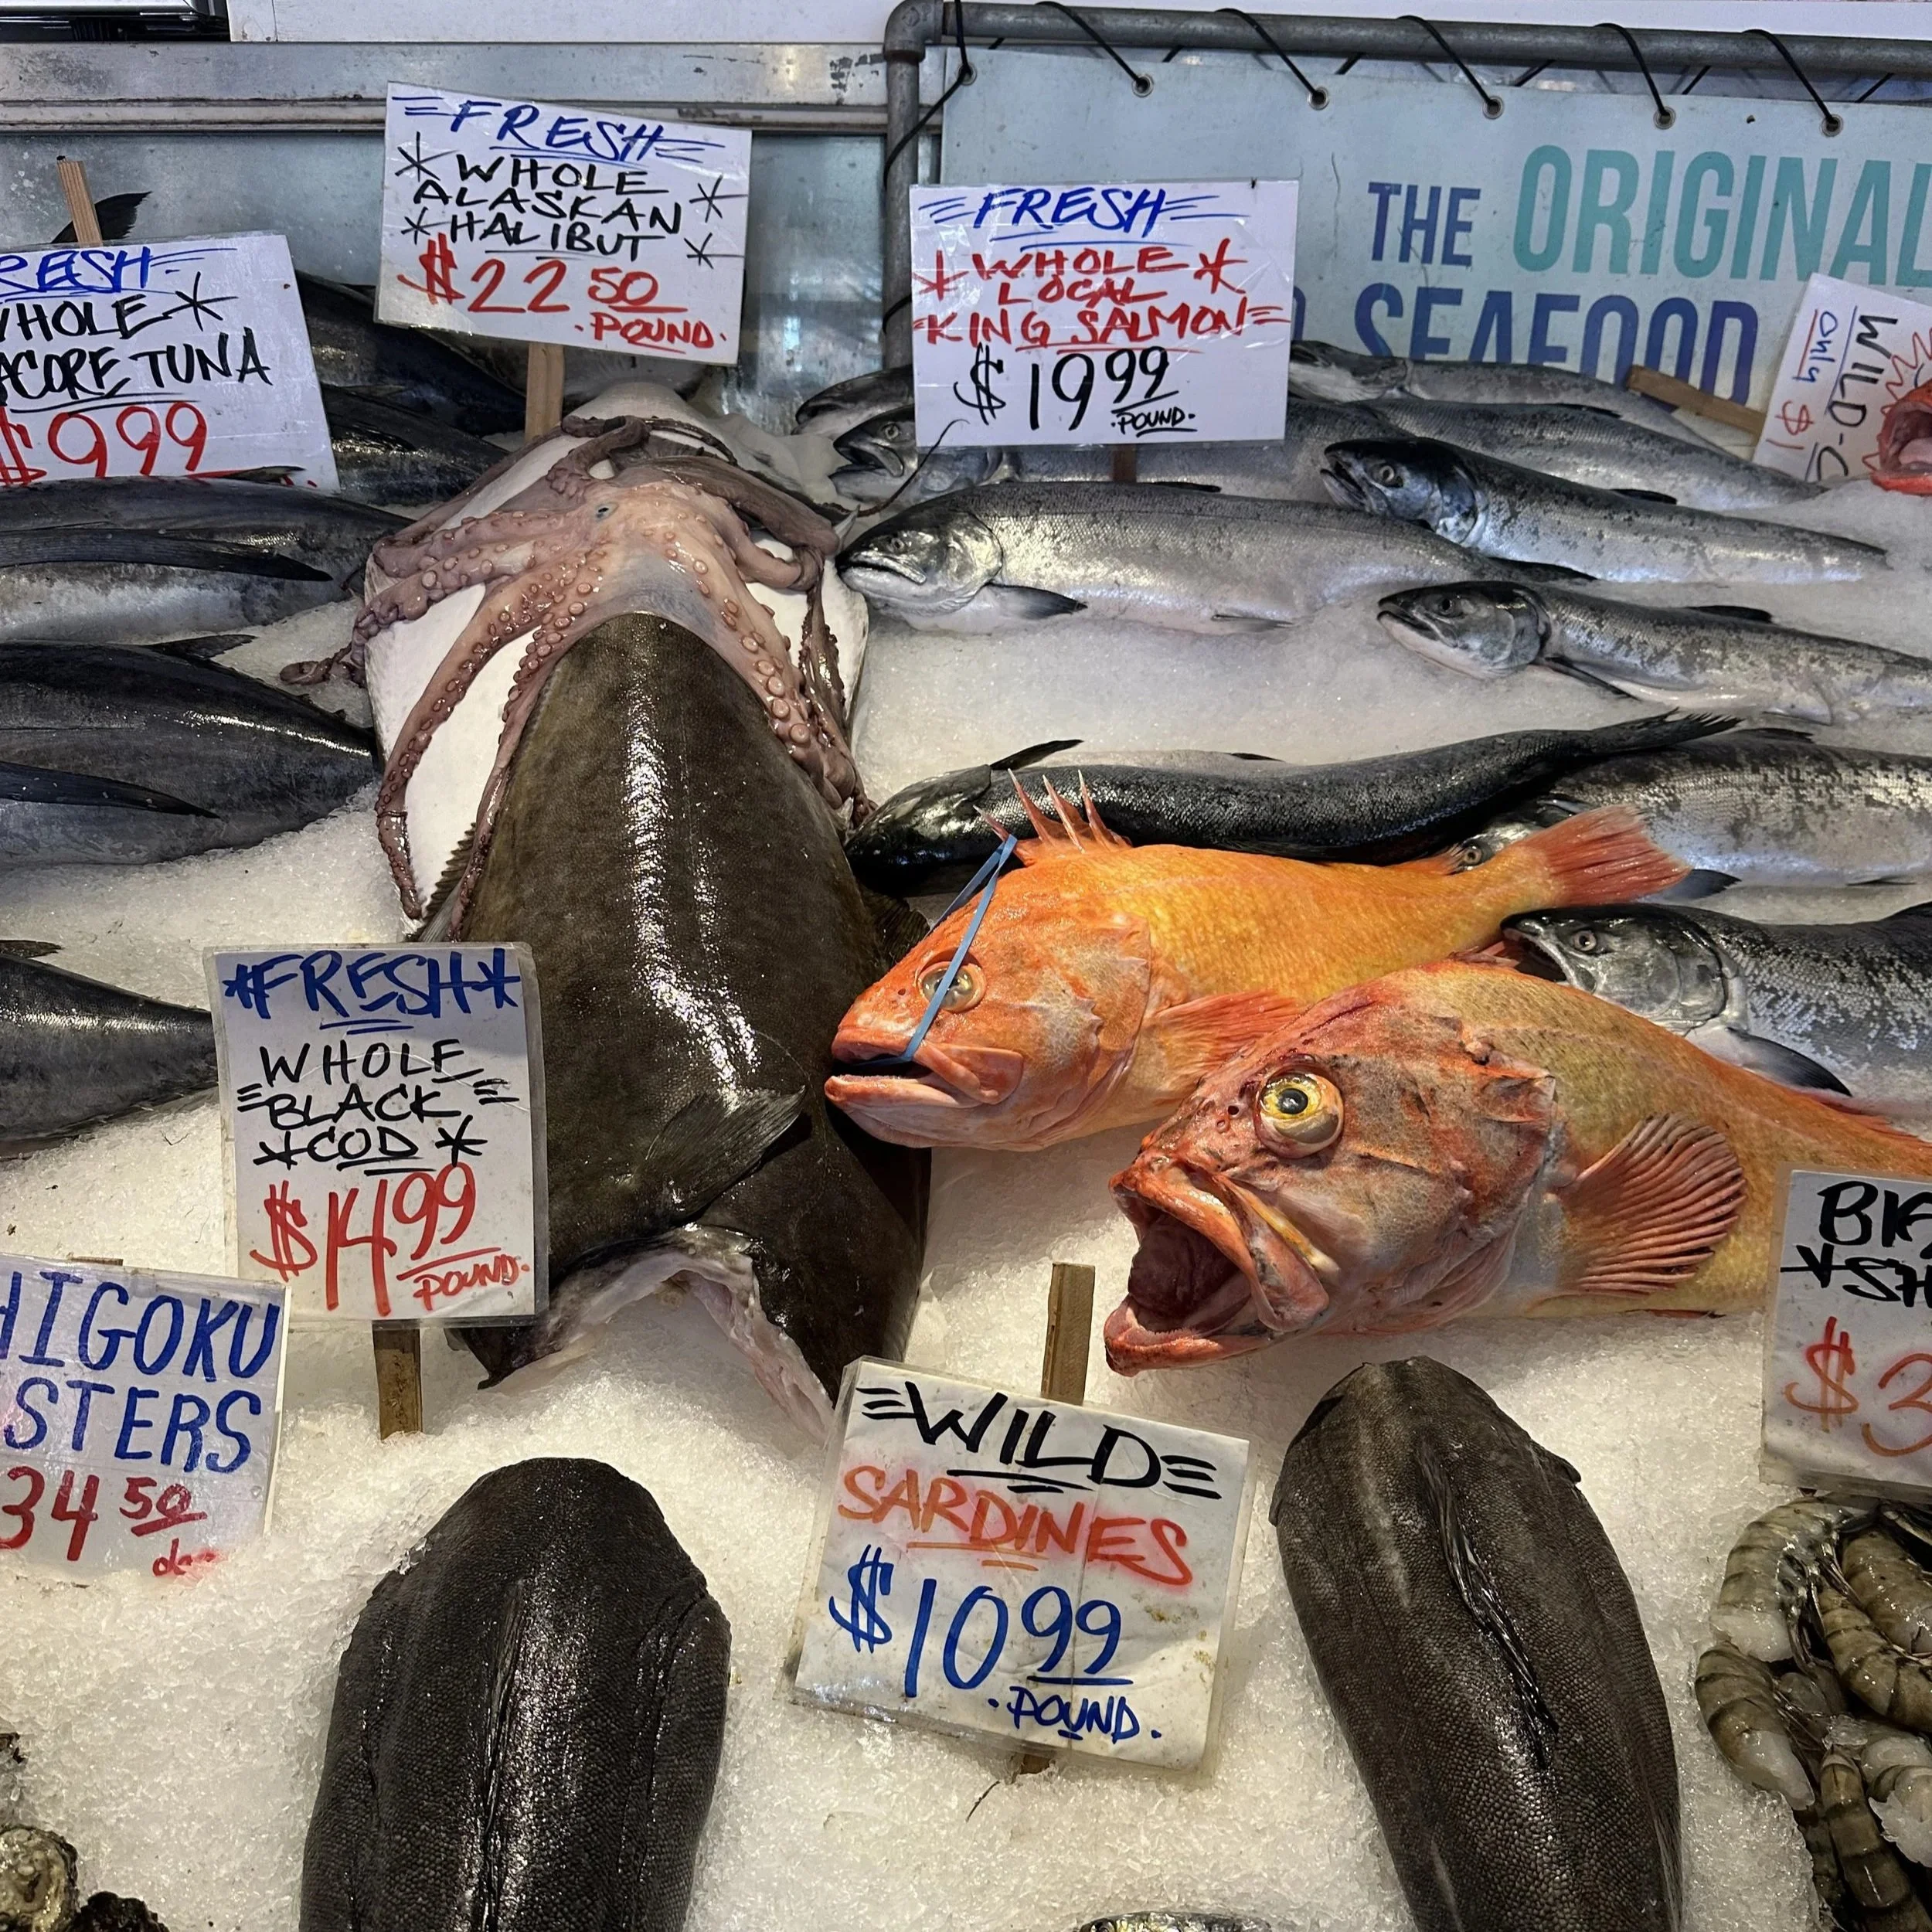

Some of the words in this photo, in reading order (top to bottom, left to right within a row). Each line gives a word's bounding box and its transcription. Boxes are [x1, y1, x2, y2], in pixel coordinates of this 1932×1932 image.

[451, 100, 665, 162] FRESH
[456, 154, 668, 195] WHOLE
[413, 179, 681, 234] ALASKAN
[974, 187, 1167, 238] FRESH
[1368, 182, 1481, 267] THE
[1512, 145, 1932, 287] ORIGINAL
[451, 211, 665, 261] HALIBUT
[972, 247, 1189, 279] WHOLE
[998, 274, 1168, 308] LOCAL
[927, 308, 1050, 347] KING
[1072, 296, 1248, 344] SALMON
[1354, 282, 1758, 412] SEAFOOD
[1793, 311, 1838, 383] only
[130, 327, 273, 388] TUNA
[252, 949, 473, 1019] FRESH
[260, 1039, 485, 1086] WHOLE
[267, 1083, 461, 1129] BLACK
[308, 1126, 419, 1162] COD
[4, 1376, 261, 1473] STERS
[904, 1381, 1162, 1488] WILD
[838, 1465, 1192, 1586] SARDINES
